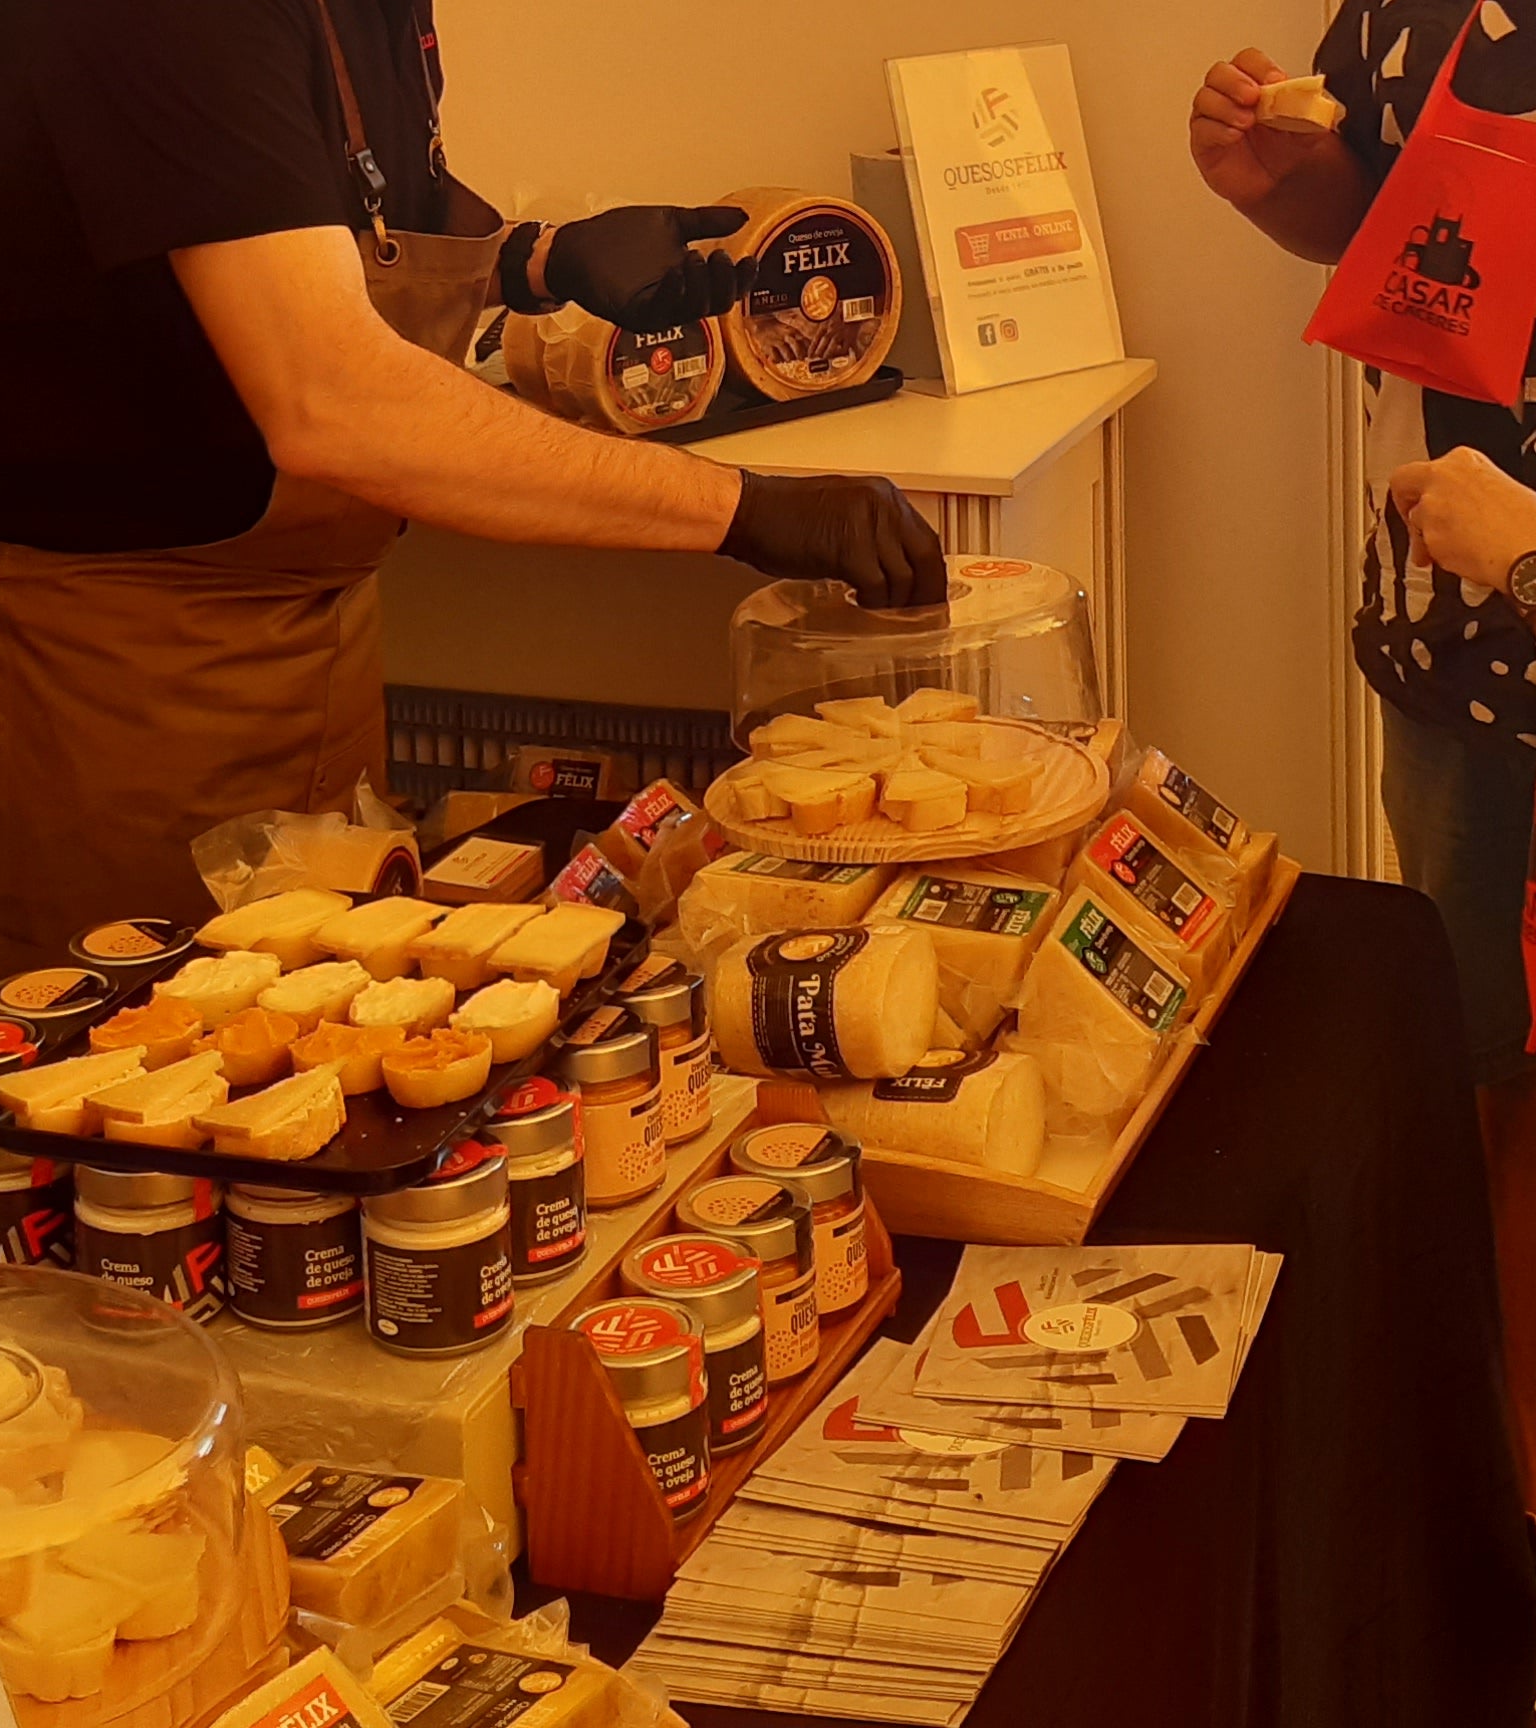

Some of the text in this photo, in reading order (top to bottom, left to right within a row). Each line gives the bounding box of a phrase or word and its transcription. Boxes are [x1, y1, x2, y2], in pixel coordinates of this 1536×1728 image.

[1033, 219, 1074, 237] ONLINE
[1384, 270, 1474, 320] CASAR
[796, 973, 821, 1037] Pata
[305, 1245, 345, 1262] Crema
[100, 1258, 140, 1273] Crema
[306, 1263, 322, 1275] de
[306, 1267, 354, 1288] de oveja
[647, 1447, 686, 1467] Crema
